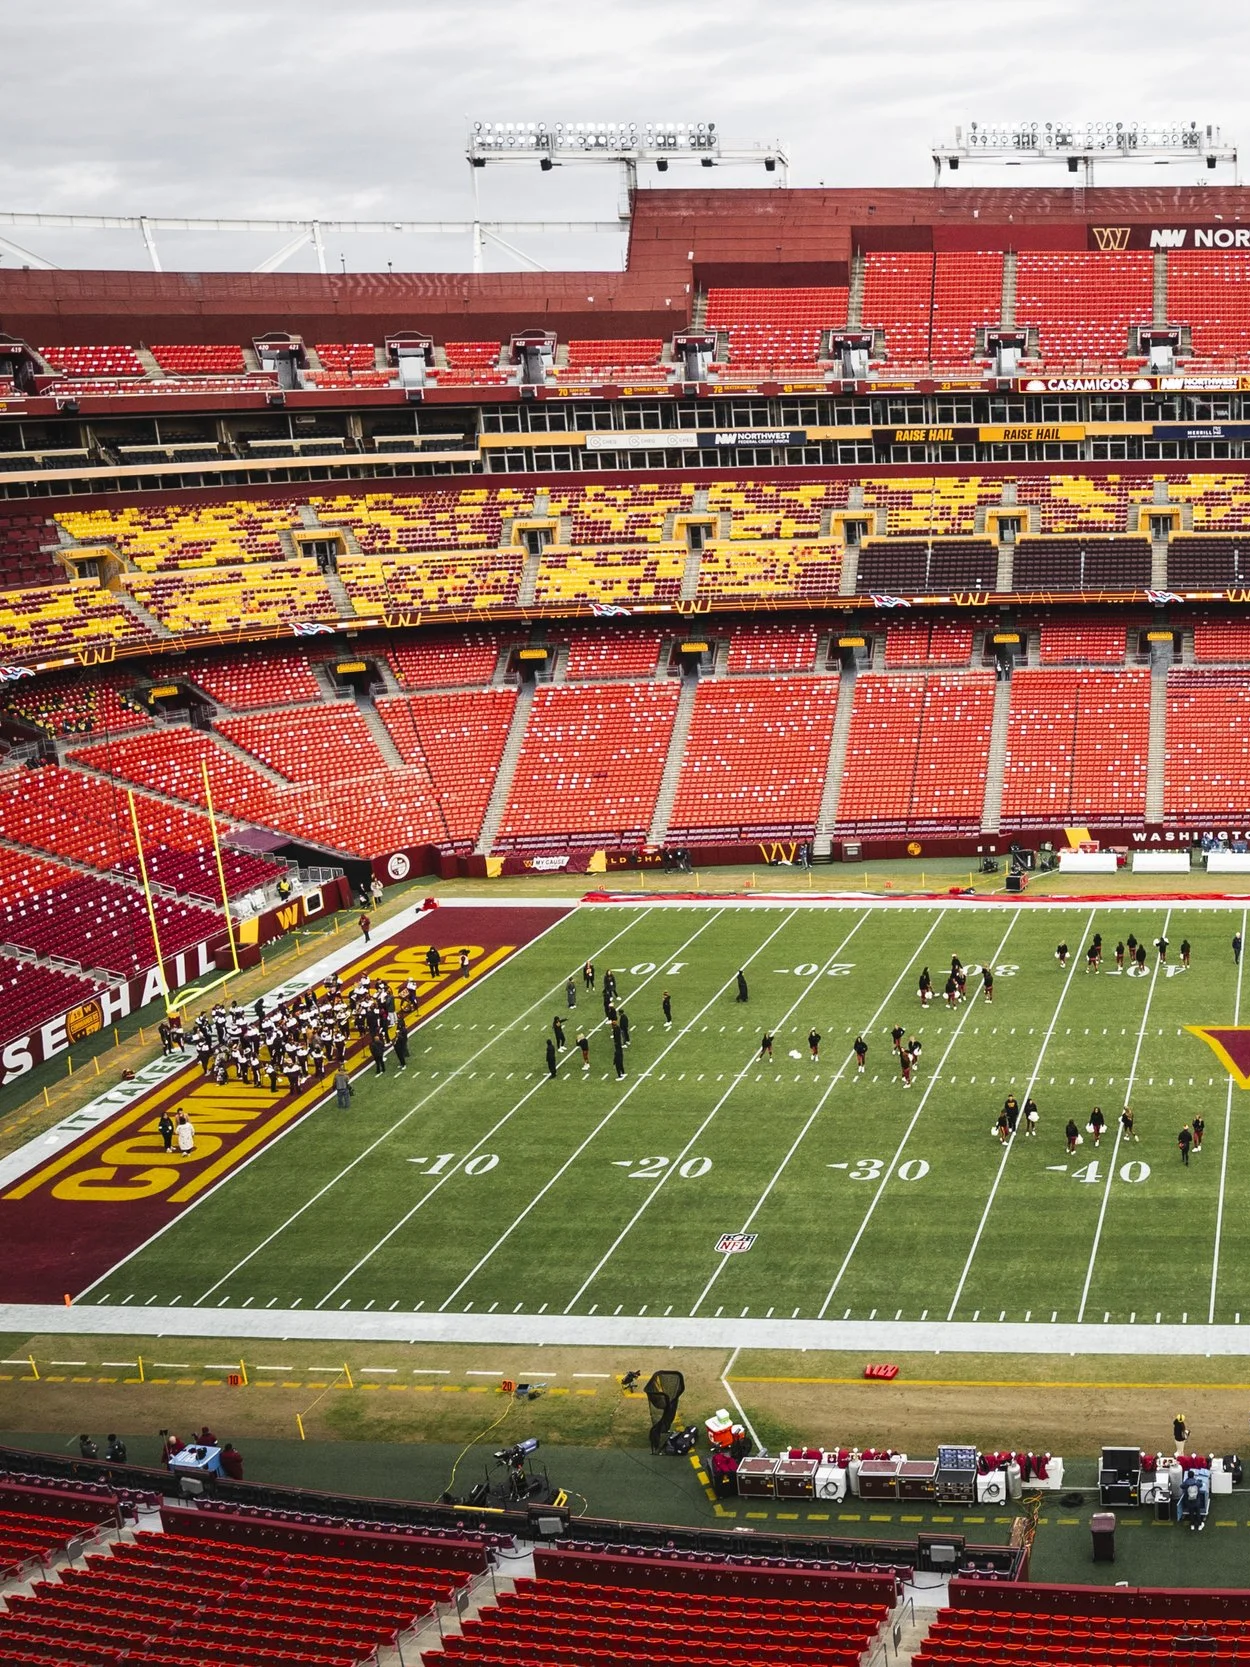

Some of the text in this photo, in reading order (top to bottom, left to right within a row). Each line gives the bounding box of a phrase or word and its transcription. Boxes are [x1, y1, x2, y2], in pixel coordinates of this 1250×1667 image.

[1150, 229, 1187, 248] NW
[1048, 378, 1130, 390] CASAMIGOS
[895, 429, 954, 441] RAISE HAIL
[1003, 428, 1060, 440] RAISE HAIL
[100, 942, 216, 1028] HAIL
[58, 1054, 193, 1132] IT TAKES
[420, 1153, 500, 1175] 10
[628, 1156, 712, 1178] 20
[849, 1159, 930, 1181] 30
[1072, 1160, 1151, 1183] 40
[720, 1241, 749, 1250] NFL
[229, 1375, 238, 1385] 10
[502, 1381, 512, 1391] 20
